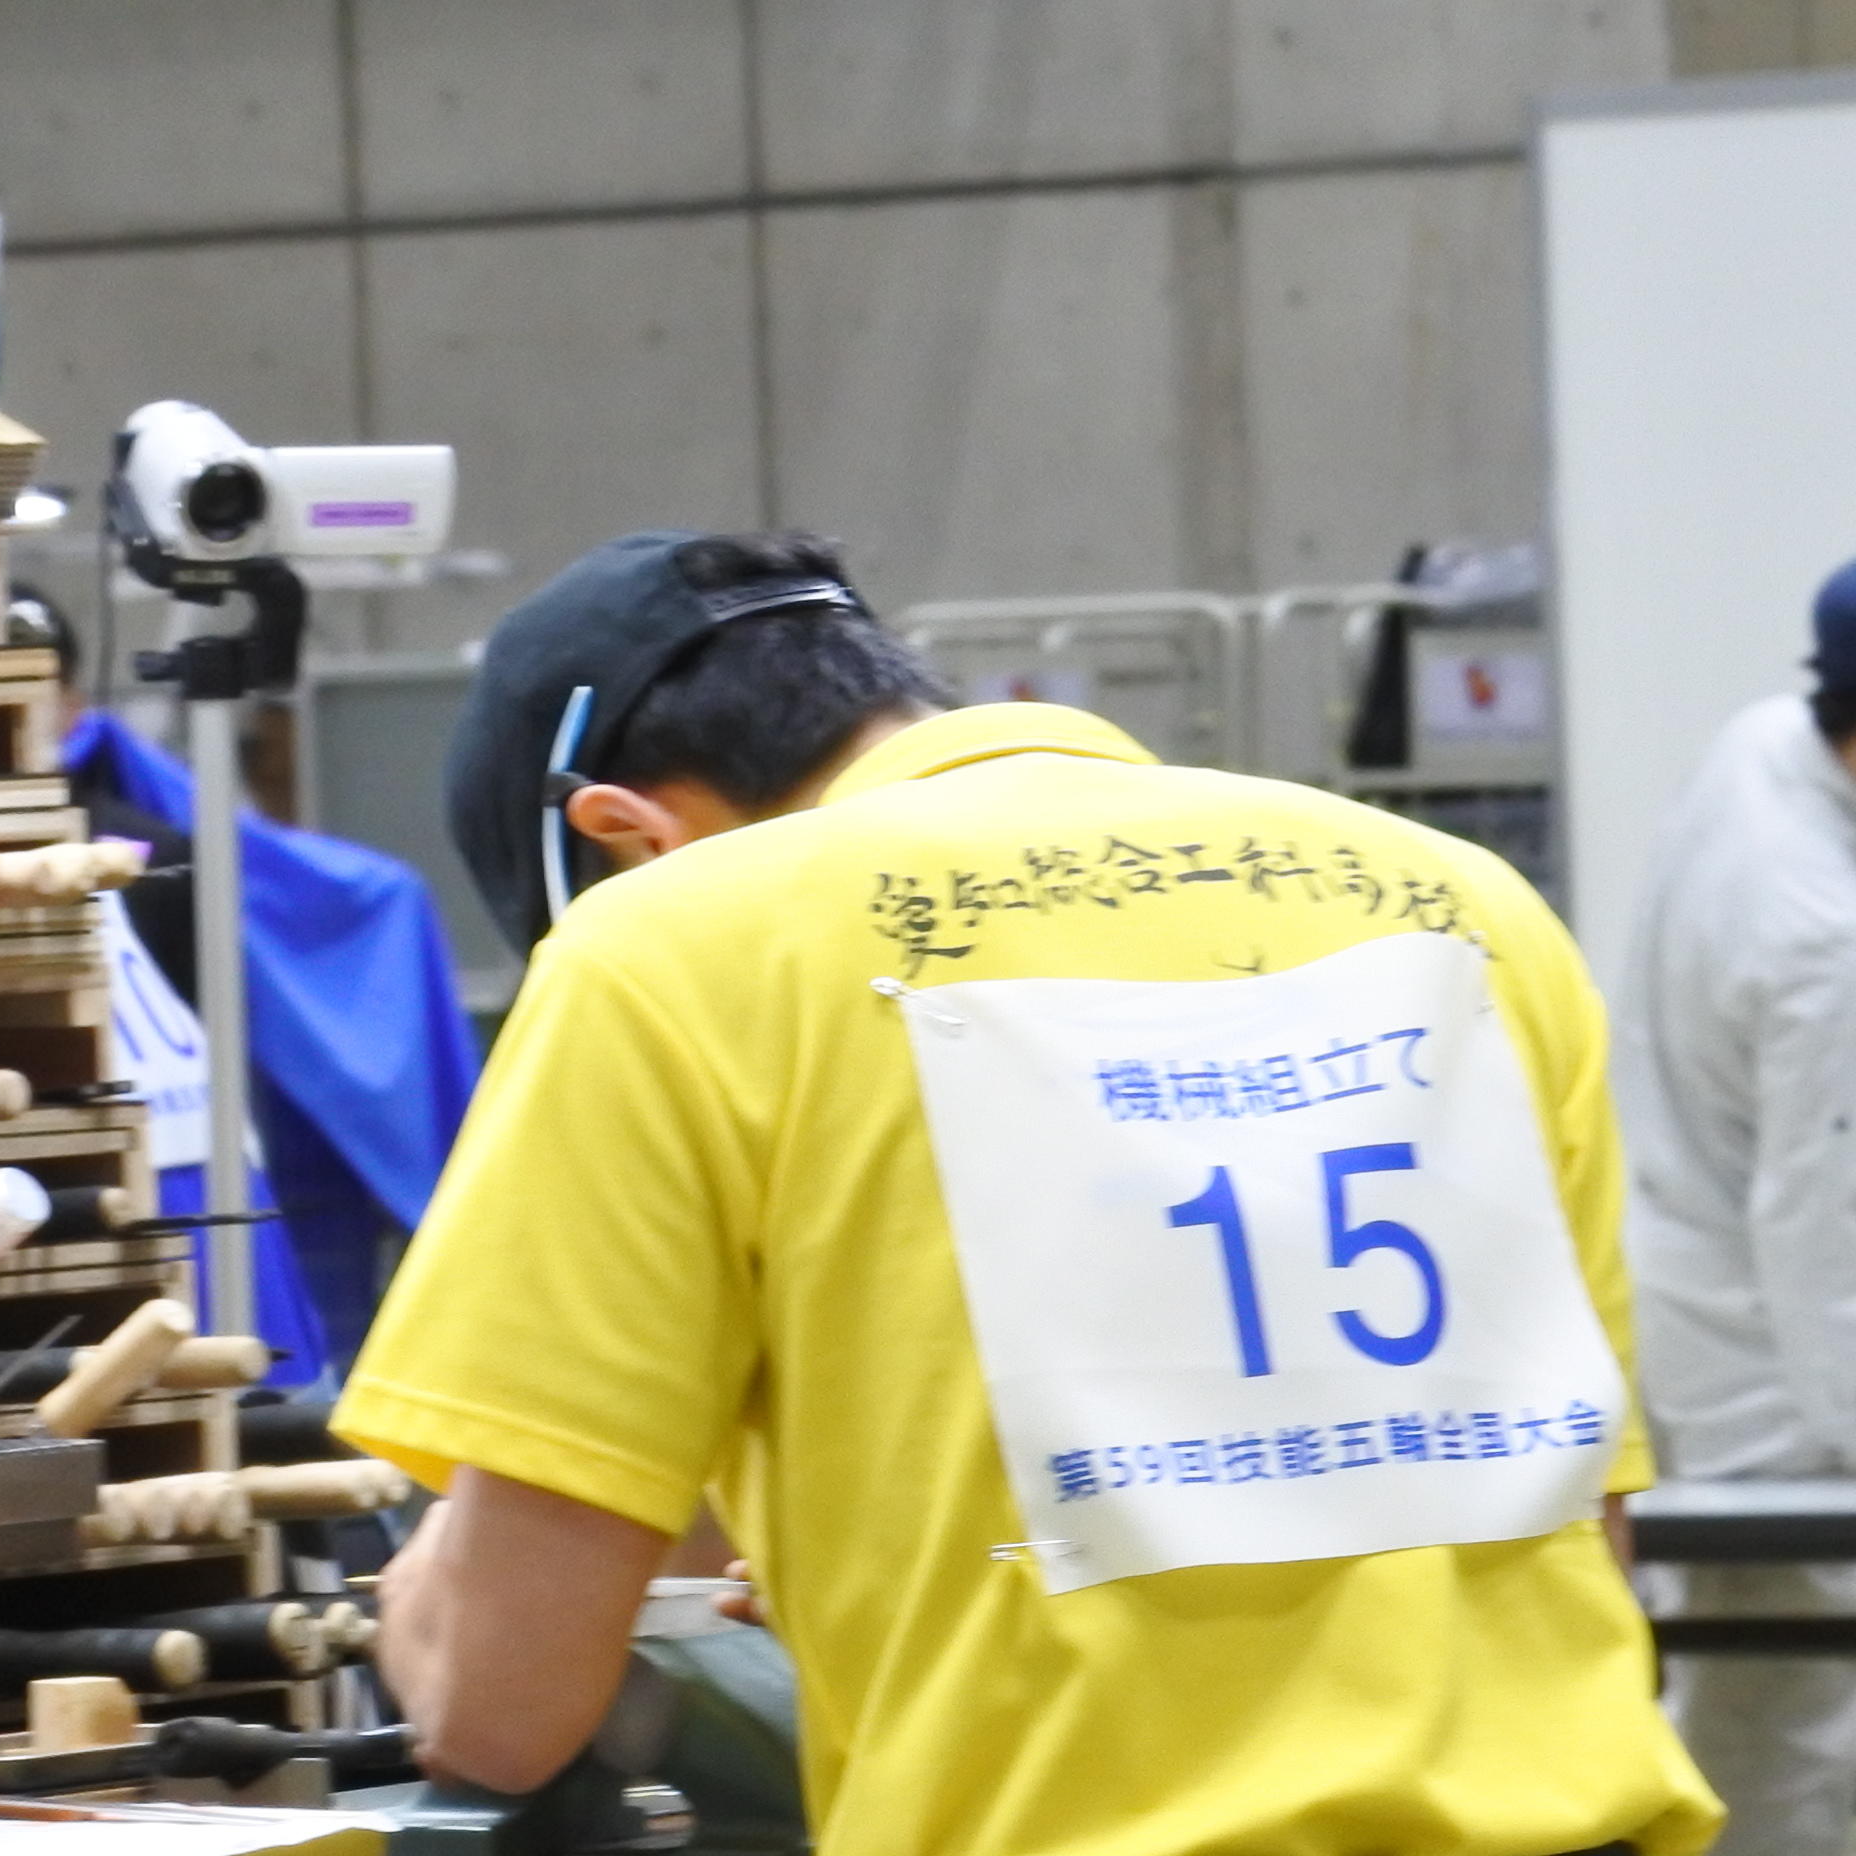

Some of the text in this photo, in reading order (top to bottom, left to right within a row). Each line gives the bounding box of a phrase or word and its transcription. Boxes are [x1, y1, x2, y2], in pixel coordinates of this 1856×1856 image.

[1094, 1026, 1432, 1122] 機械組立て
[1165, 1141, 1447, 1378] 15
[1049, 1399, 1605, 1502] 第59回技能五輪全国大会
